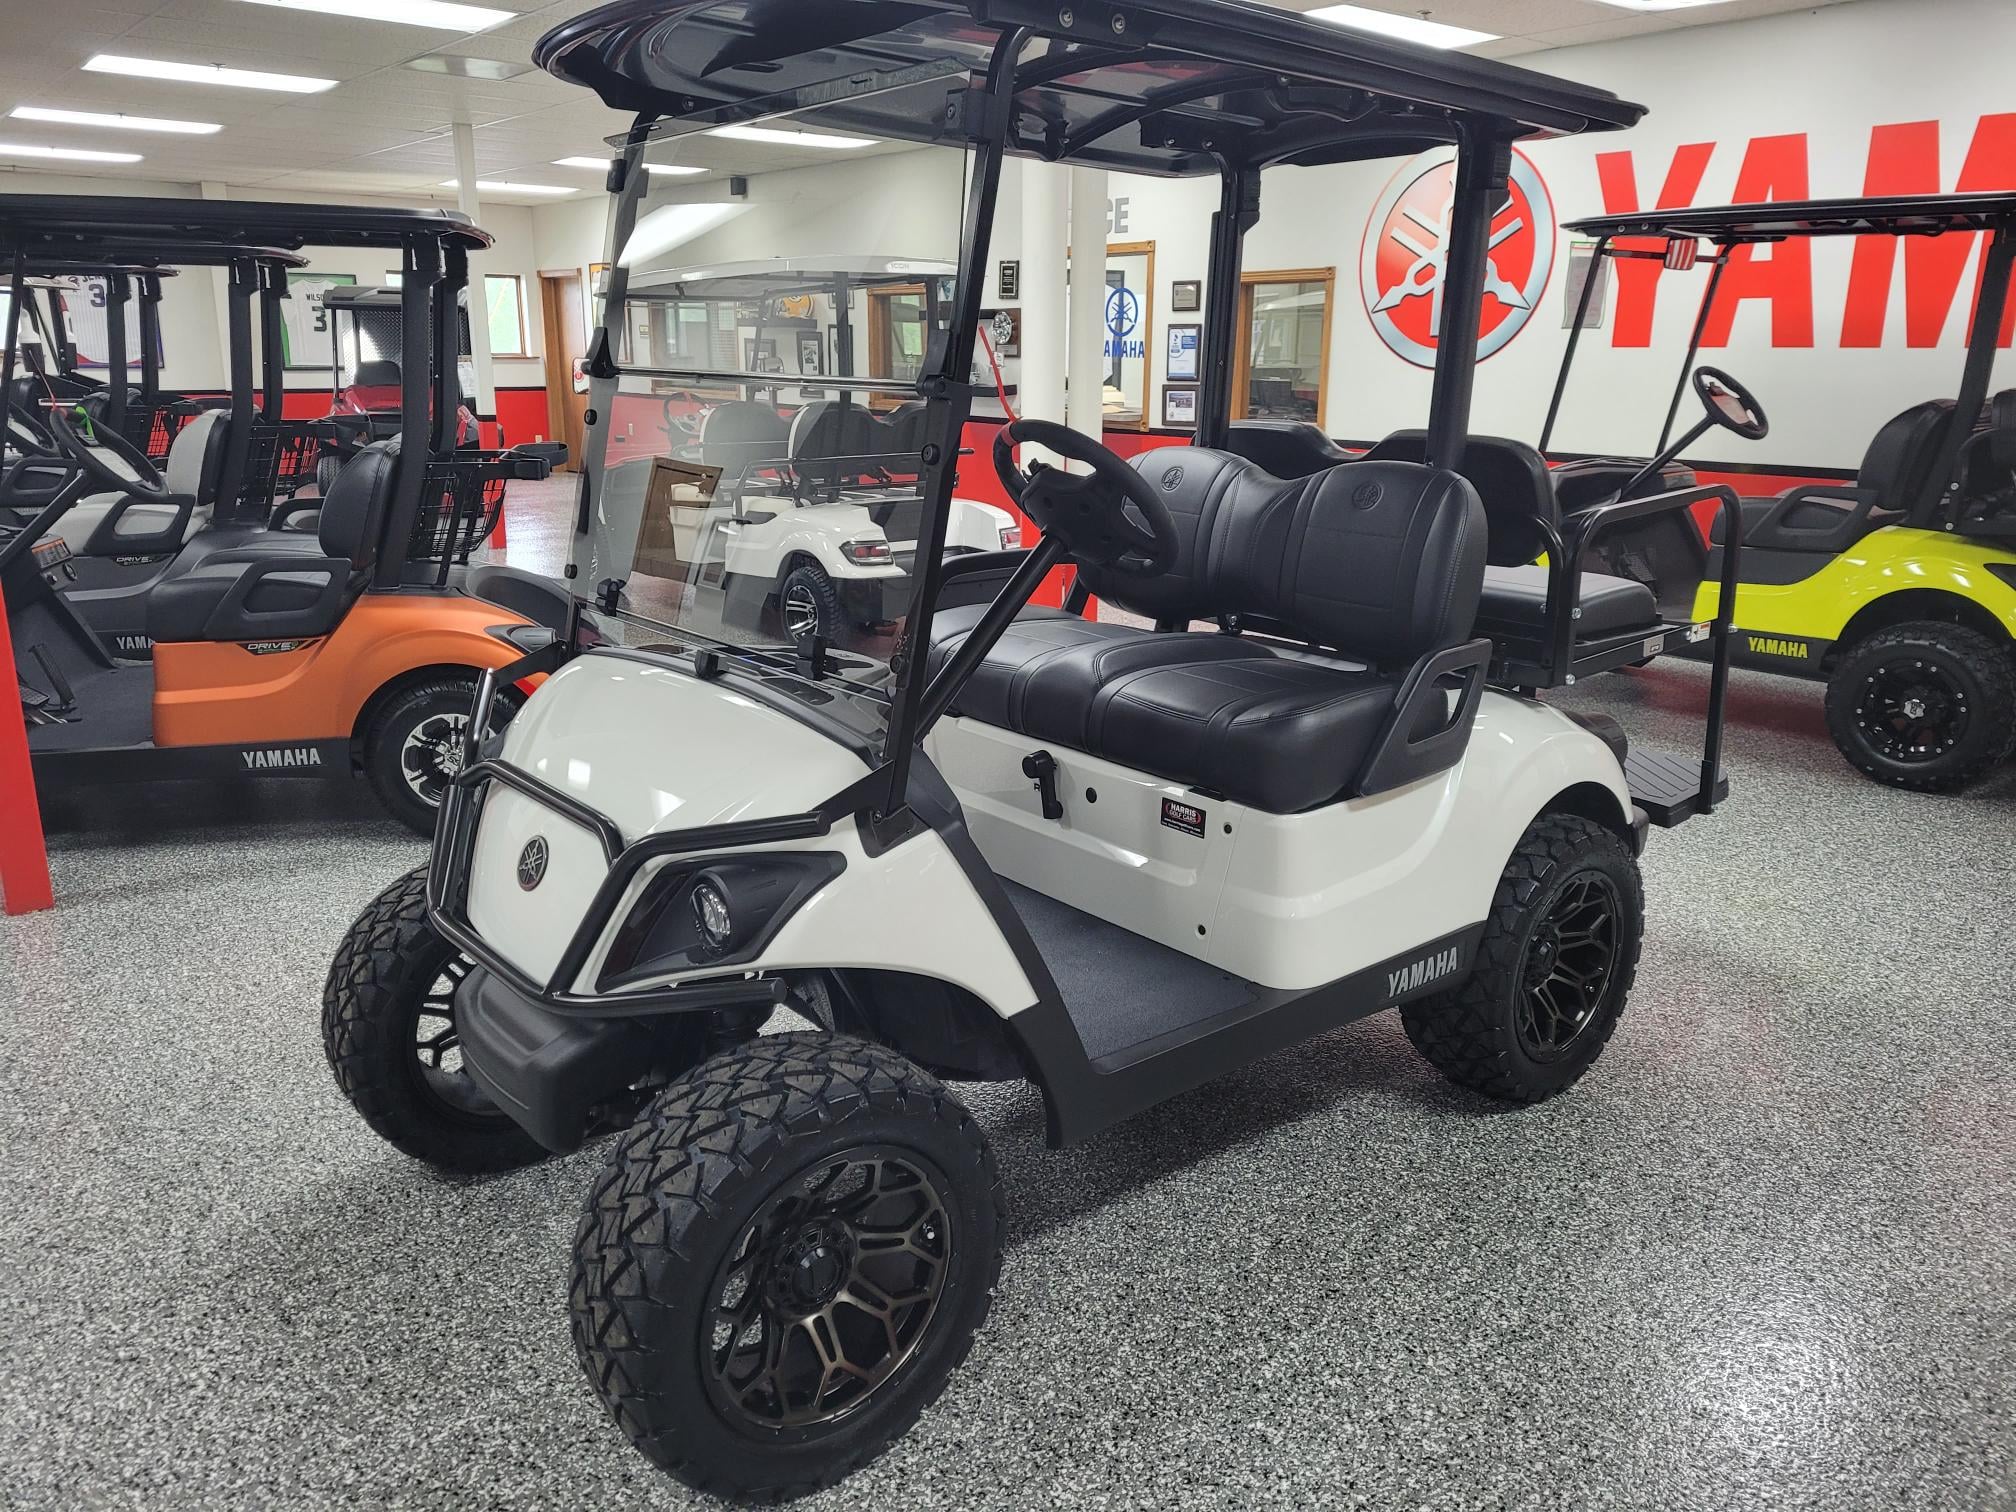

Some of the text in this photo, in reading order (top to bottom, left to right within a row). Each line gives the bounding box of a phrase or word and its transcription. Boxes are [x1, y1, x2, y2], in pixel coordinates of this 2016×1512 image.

[311, 305, 327, 332] 3
[1748, 636, 1809, 659] YAMAHA
[241, 748, 322, 768] YAMAHA
[1170, 802, 1197, 817] HARRIS
[1387, 946, 1458, 998] YAMAHA
